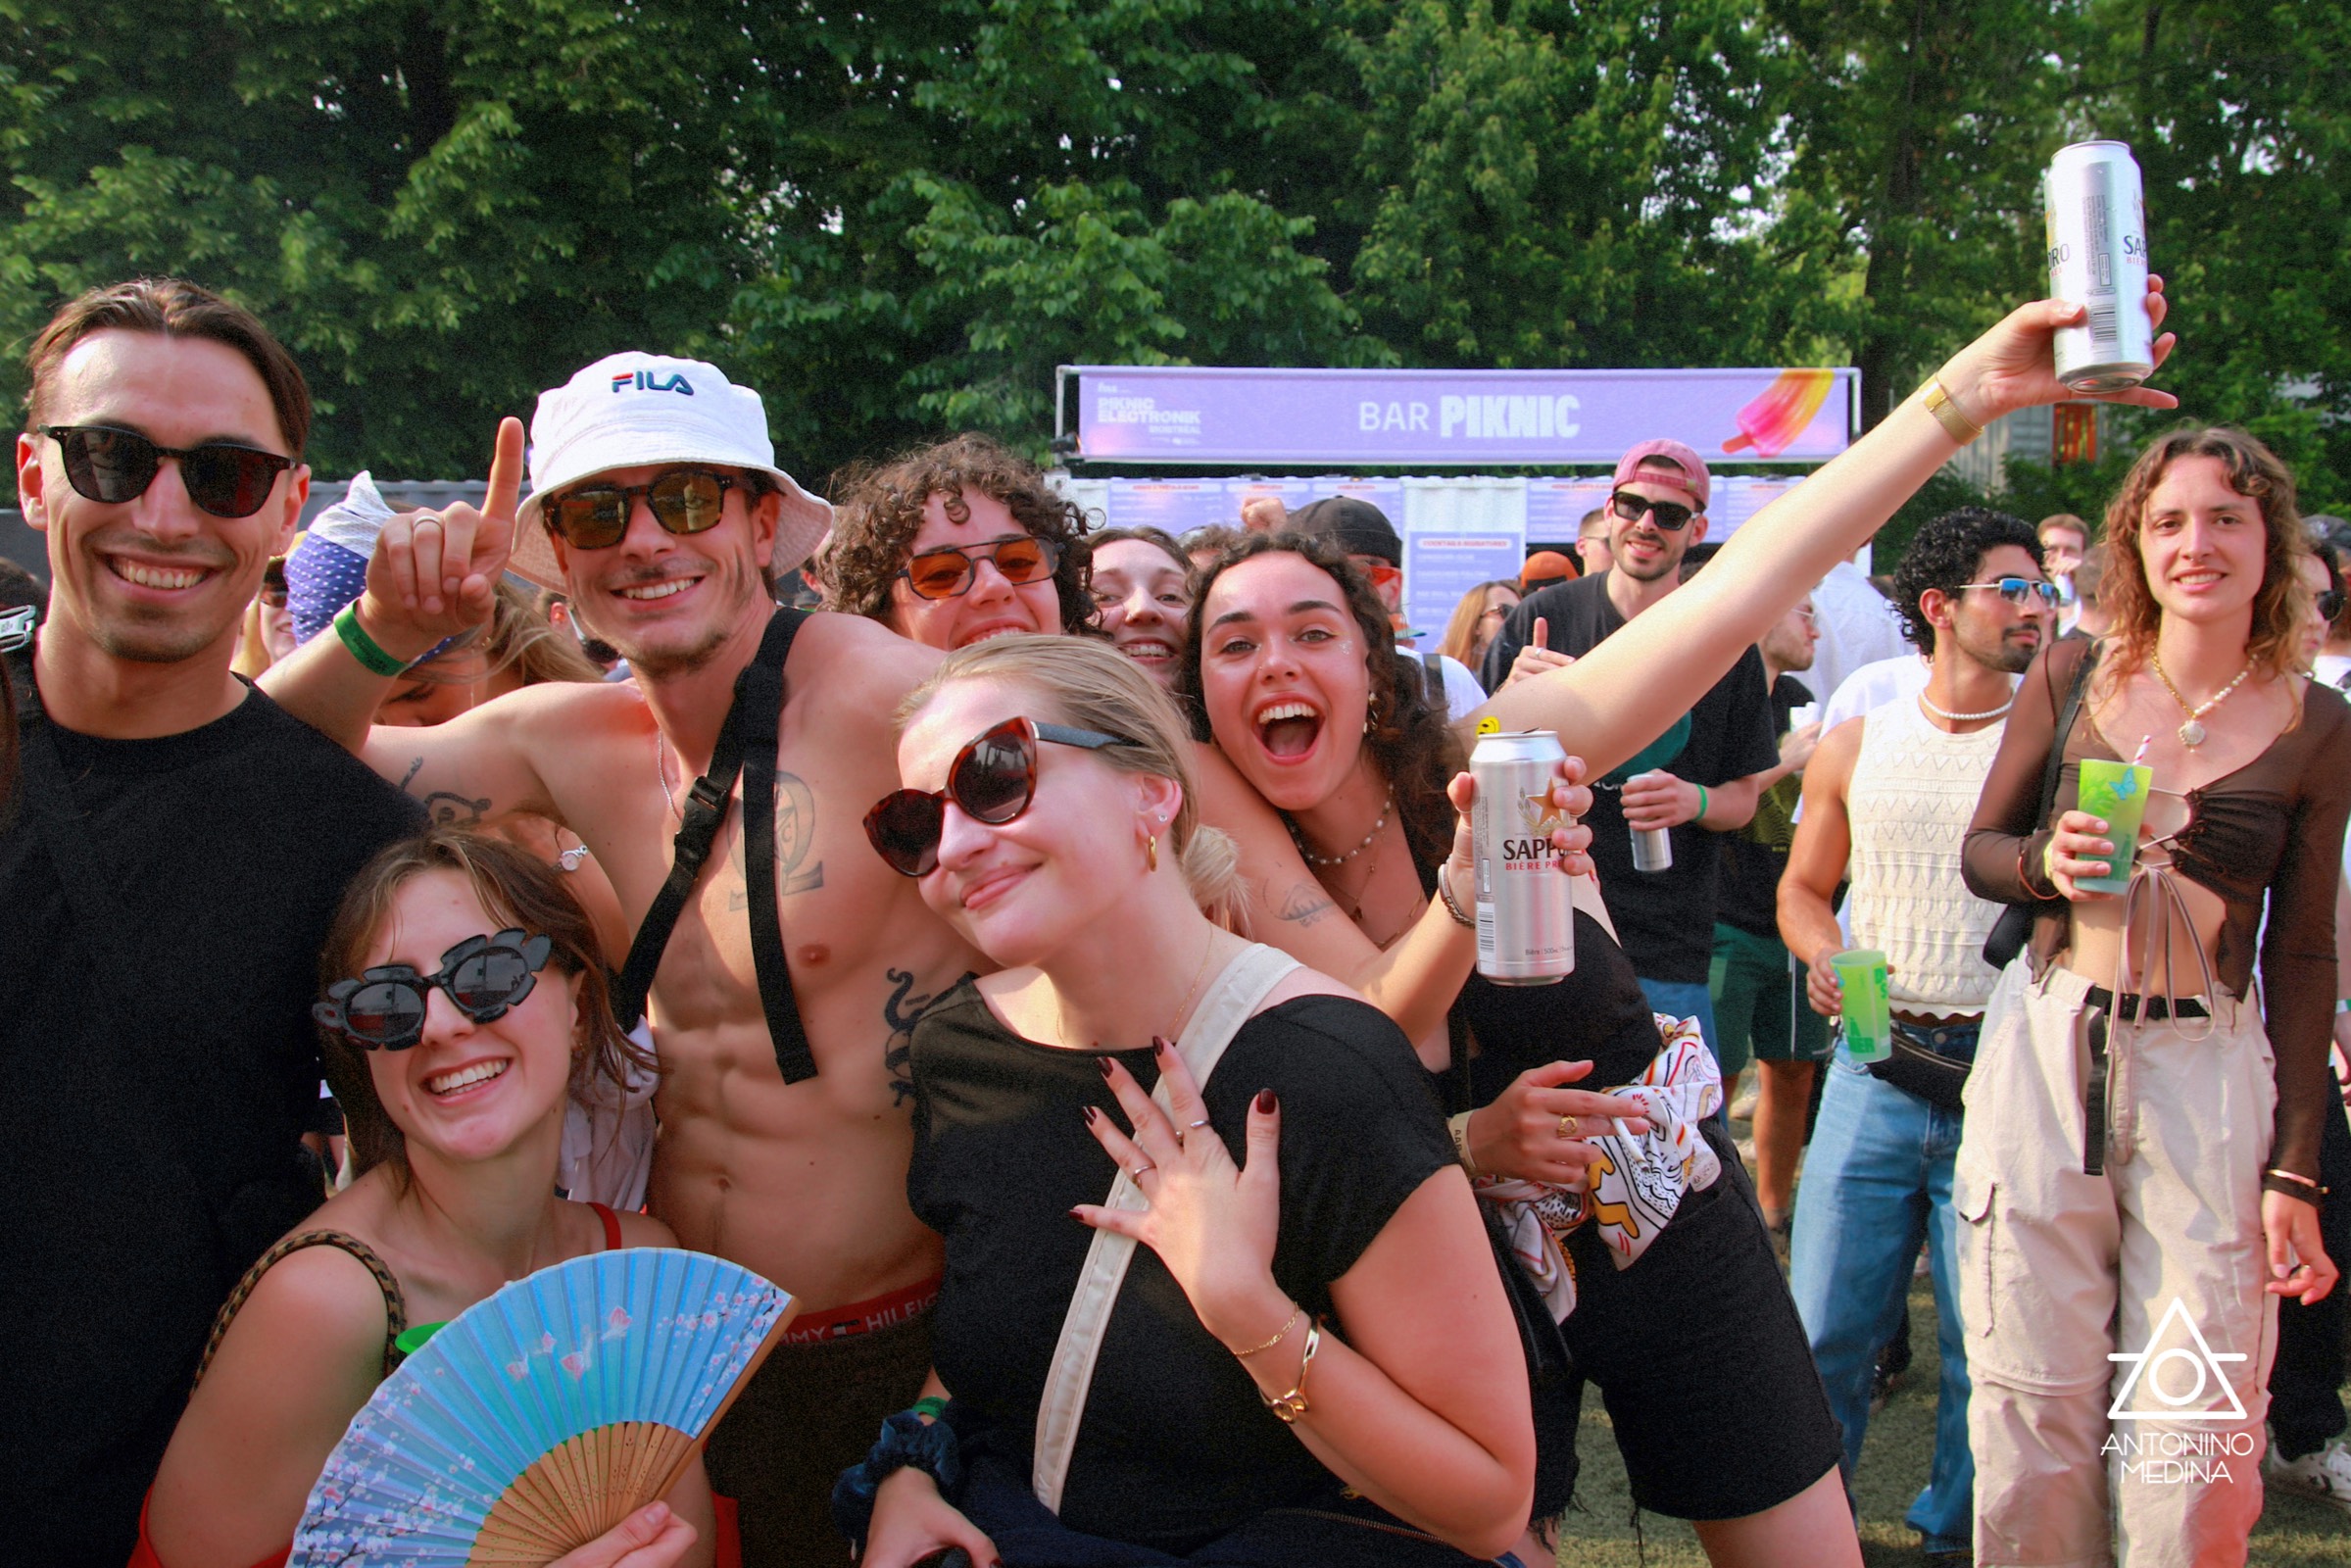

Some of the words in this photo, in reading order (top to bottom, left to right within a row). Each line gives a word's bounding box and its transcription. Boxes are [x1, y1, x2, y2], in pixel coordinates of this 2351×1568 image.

[612, 370, 695, 396] FILA
[1098, 397, 1154, 410] PIKNIC
[1358, 401, 1429, 431] BAR
[1440, 395, 1582, 438] PIKNIC
[1505, 860, 1542, 871] BIÈRE
